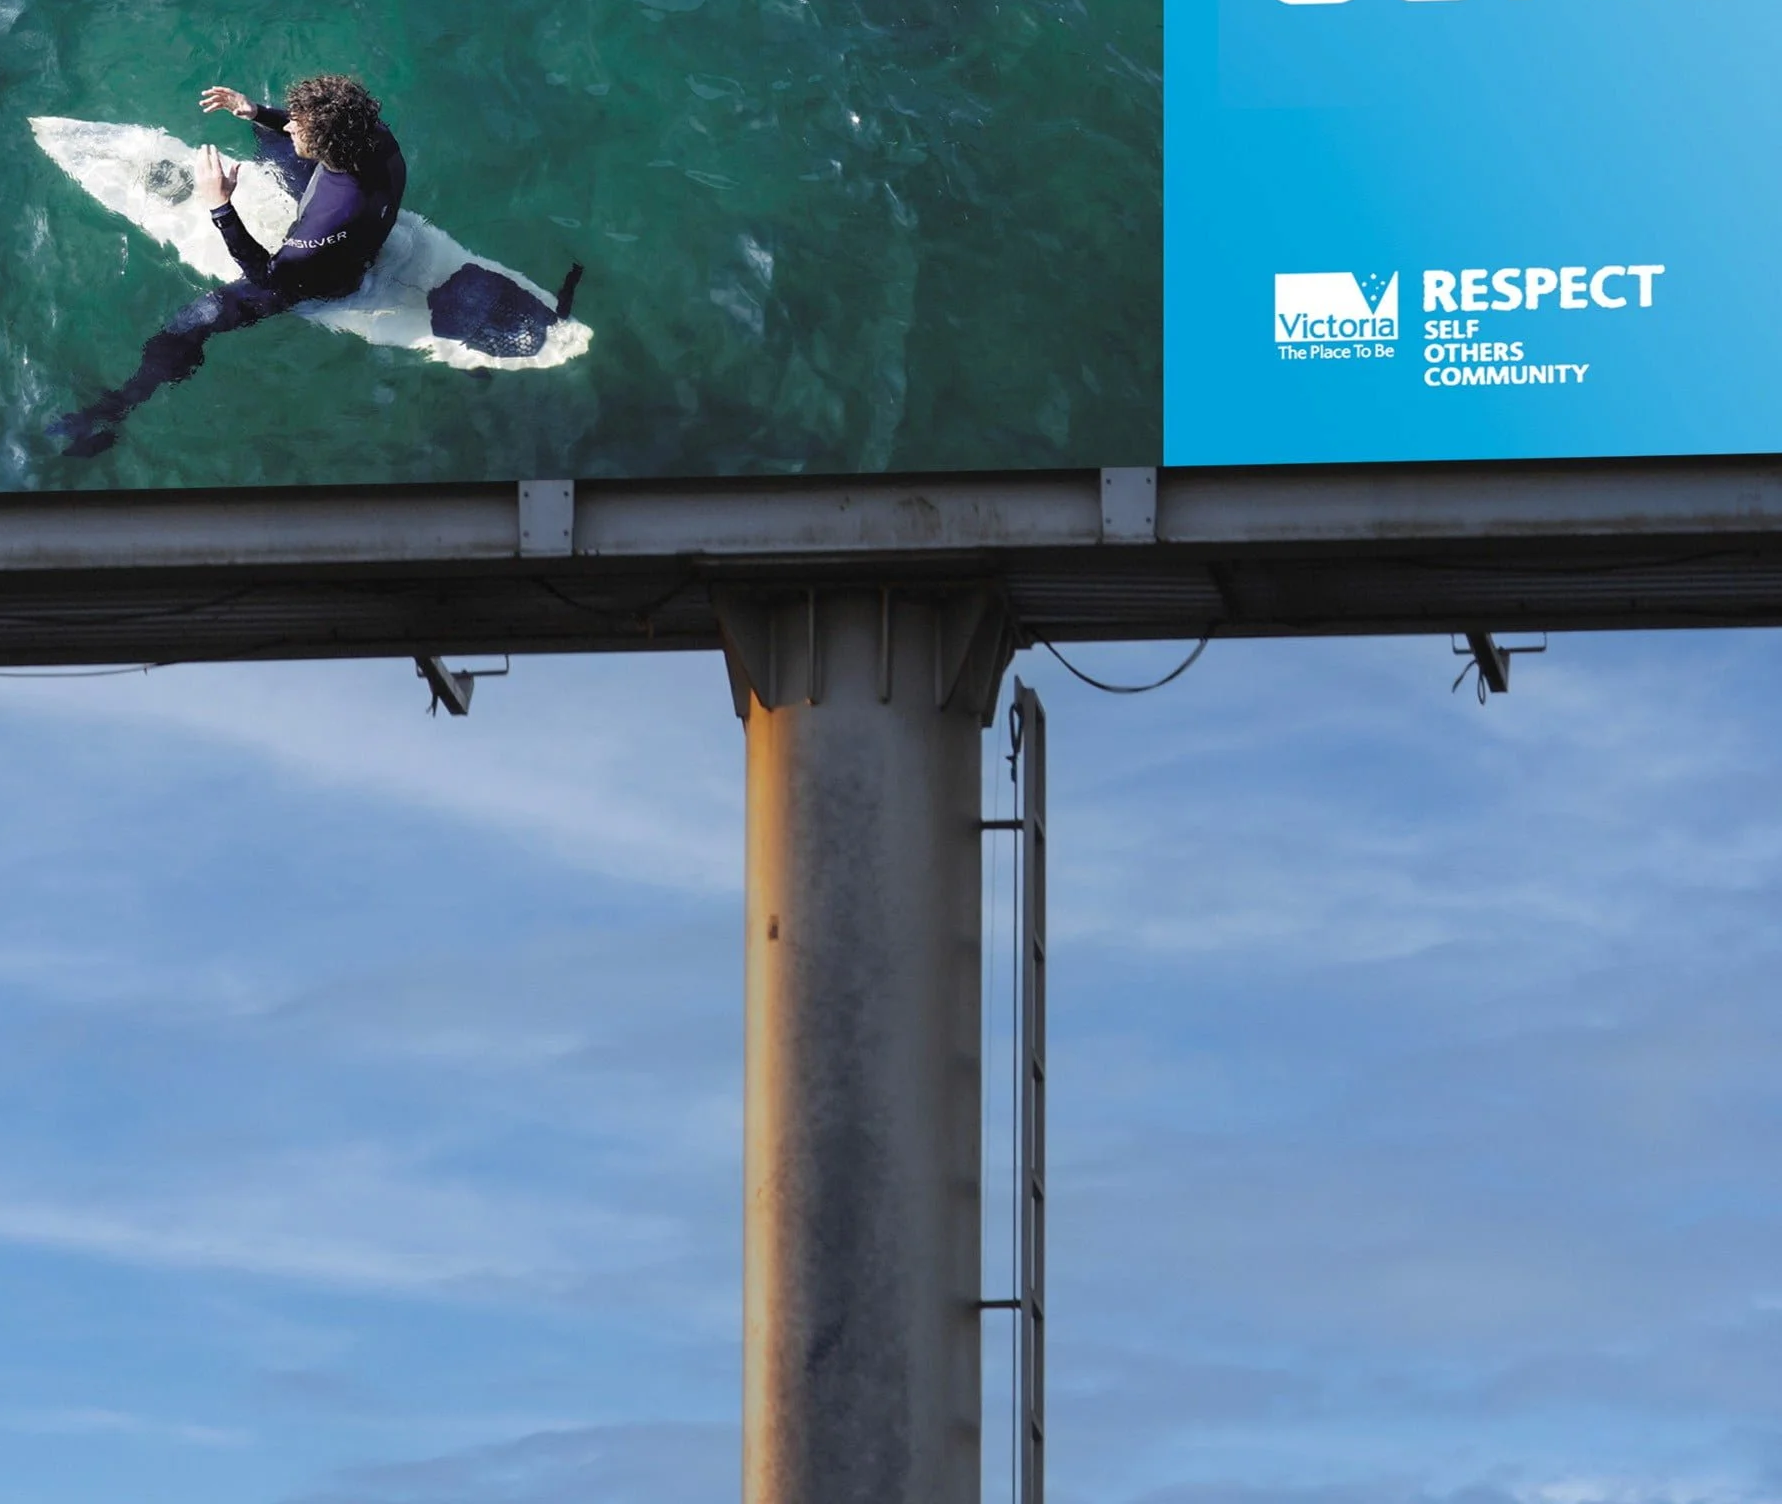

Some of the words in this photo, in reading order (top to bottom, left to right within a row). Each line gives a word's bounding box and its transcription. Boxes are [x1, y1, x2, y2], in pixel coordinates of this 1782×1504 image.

[1423, 264, 1666, 312] RESPECT
[1278, 313, 1395, 339] Victoria
[1424, 319, 1480, 340] SELF
[1277, 344, 1307, 360] The
[1310, 344, 1351, 359] Place
[1353, 343, 1372, 358] To
[1374, 343, 1395, 357] Be
[1424, 341, 1524, 363] OTHERS
[1424, 364, 1589, 387] COMMUNITY
